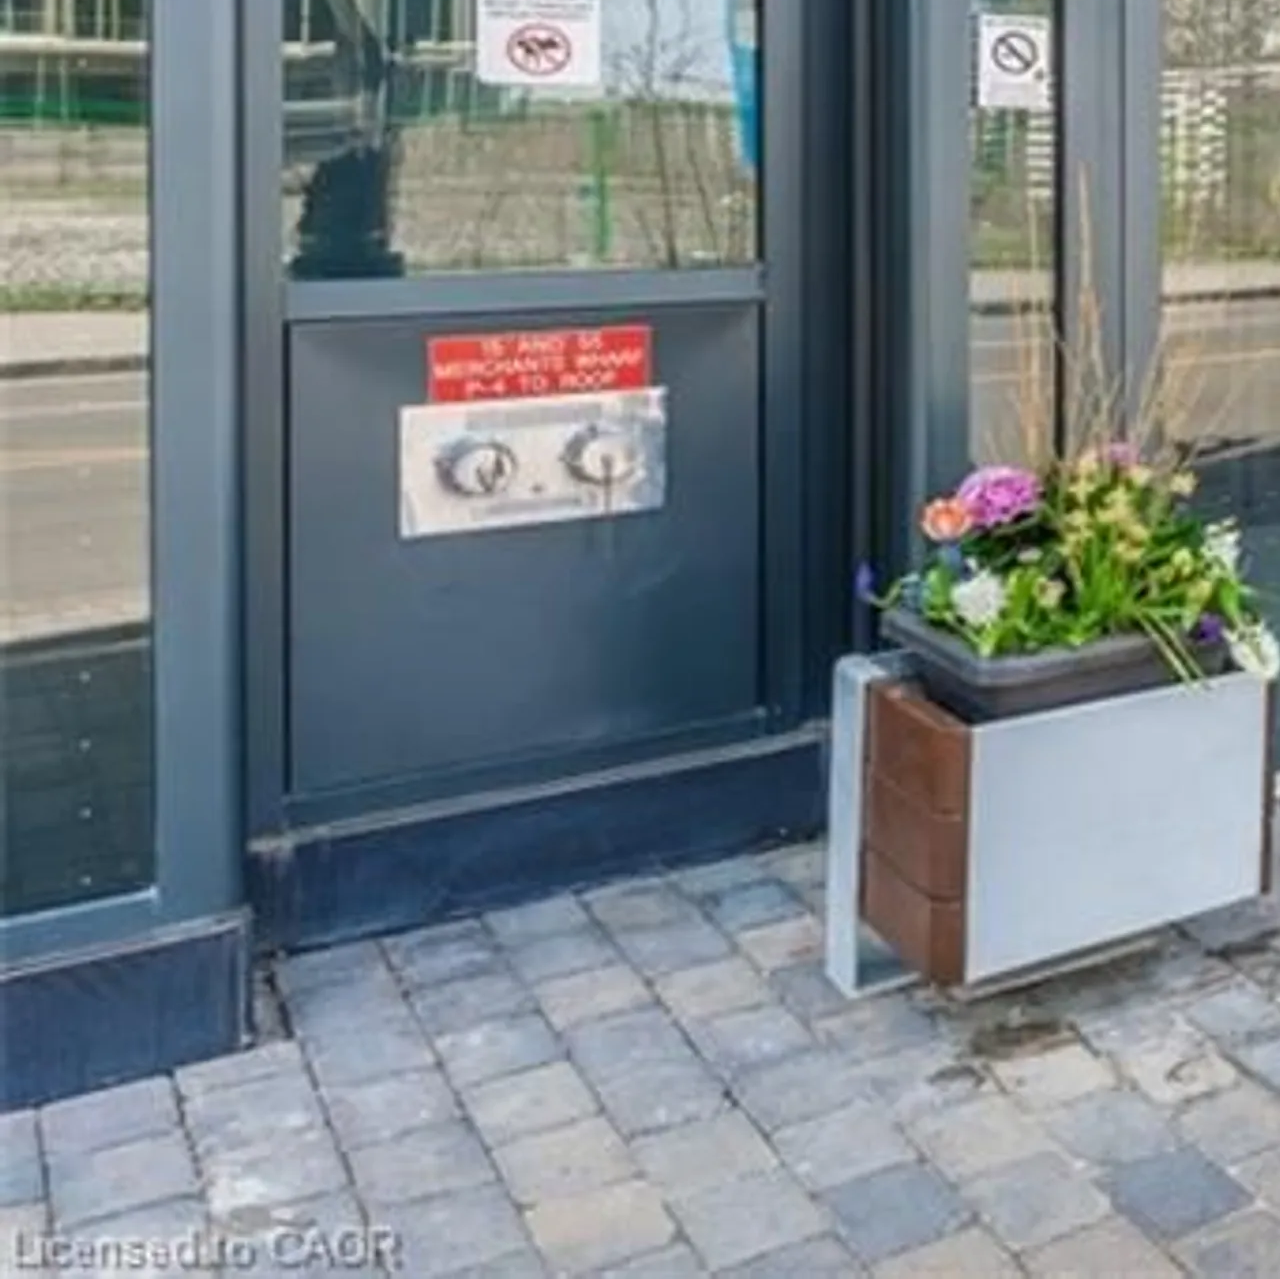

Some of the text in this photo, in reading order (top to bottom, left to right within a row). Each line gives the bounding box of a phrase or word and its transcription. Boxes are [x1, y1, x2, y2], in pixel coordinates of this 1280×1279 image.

[516, 336, 567, 352] AND
[433, 354, 566, 379] MERCHANTS
[519, 376, 549, 392] TO
[558, 371, 618, 390] ROOF
